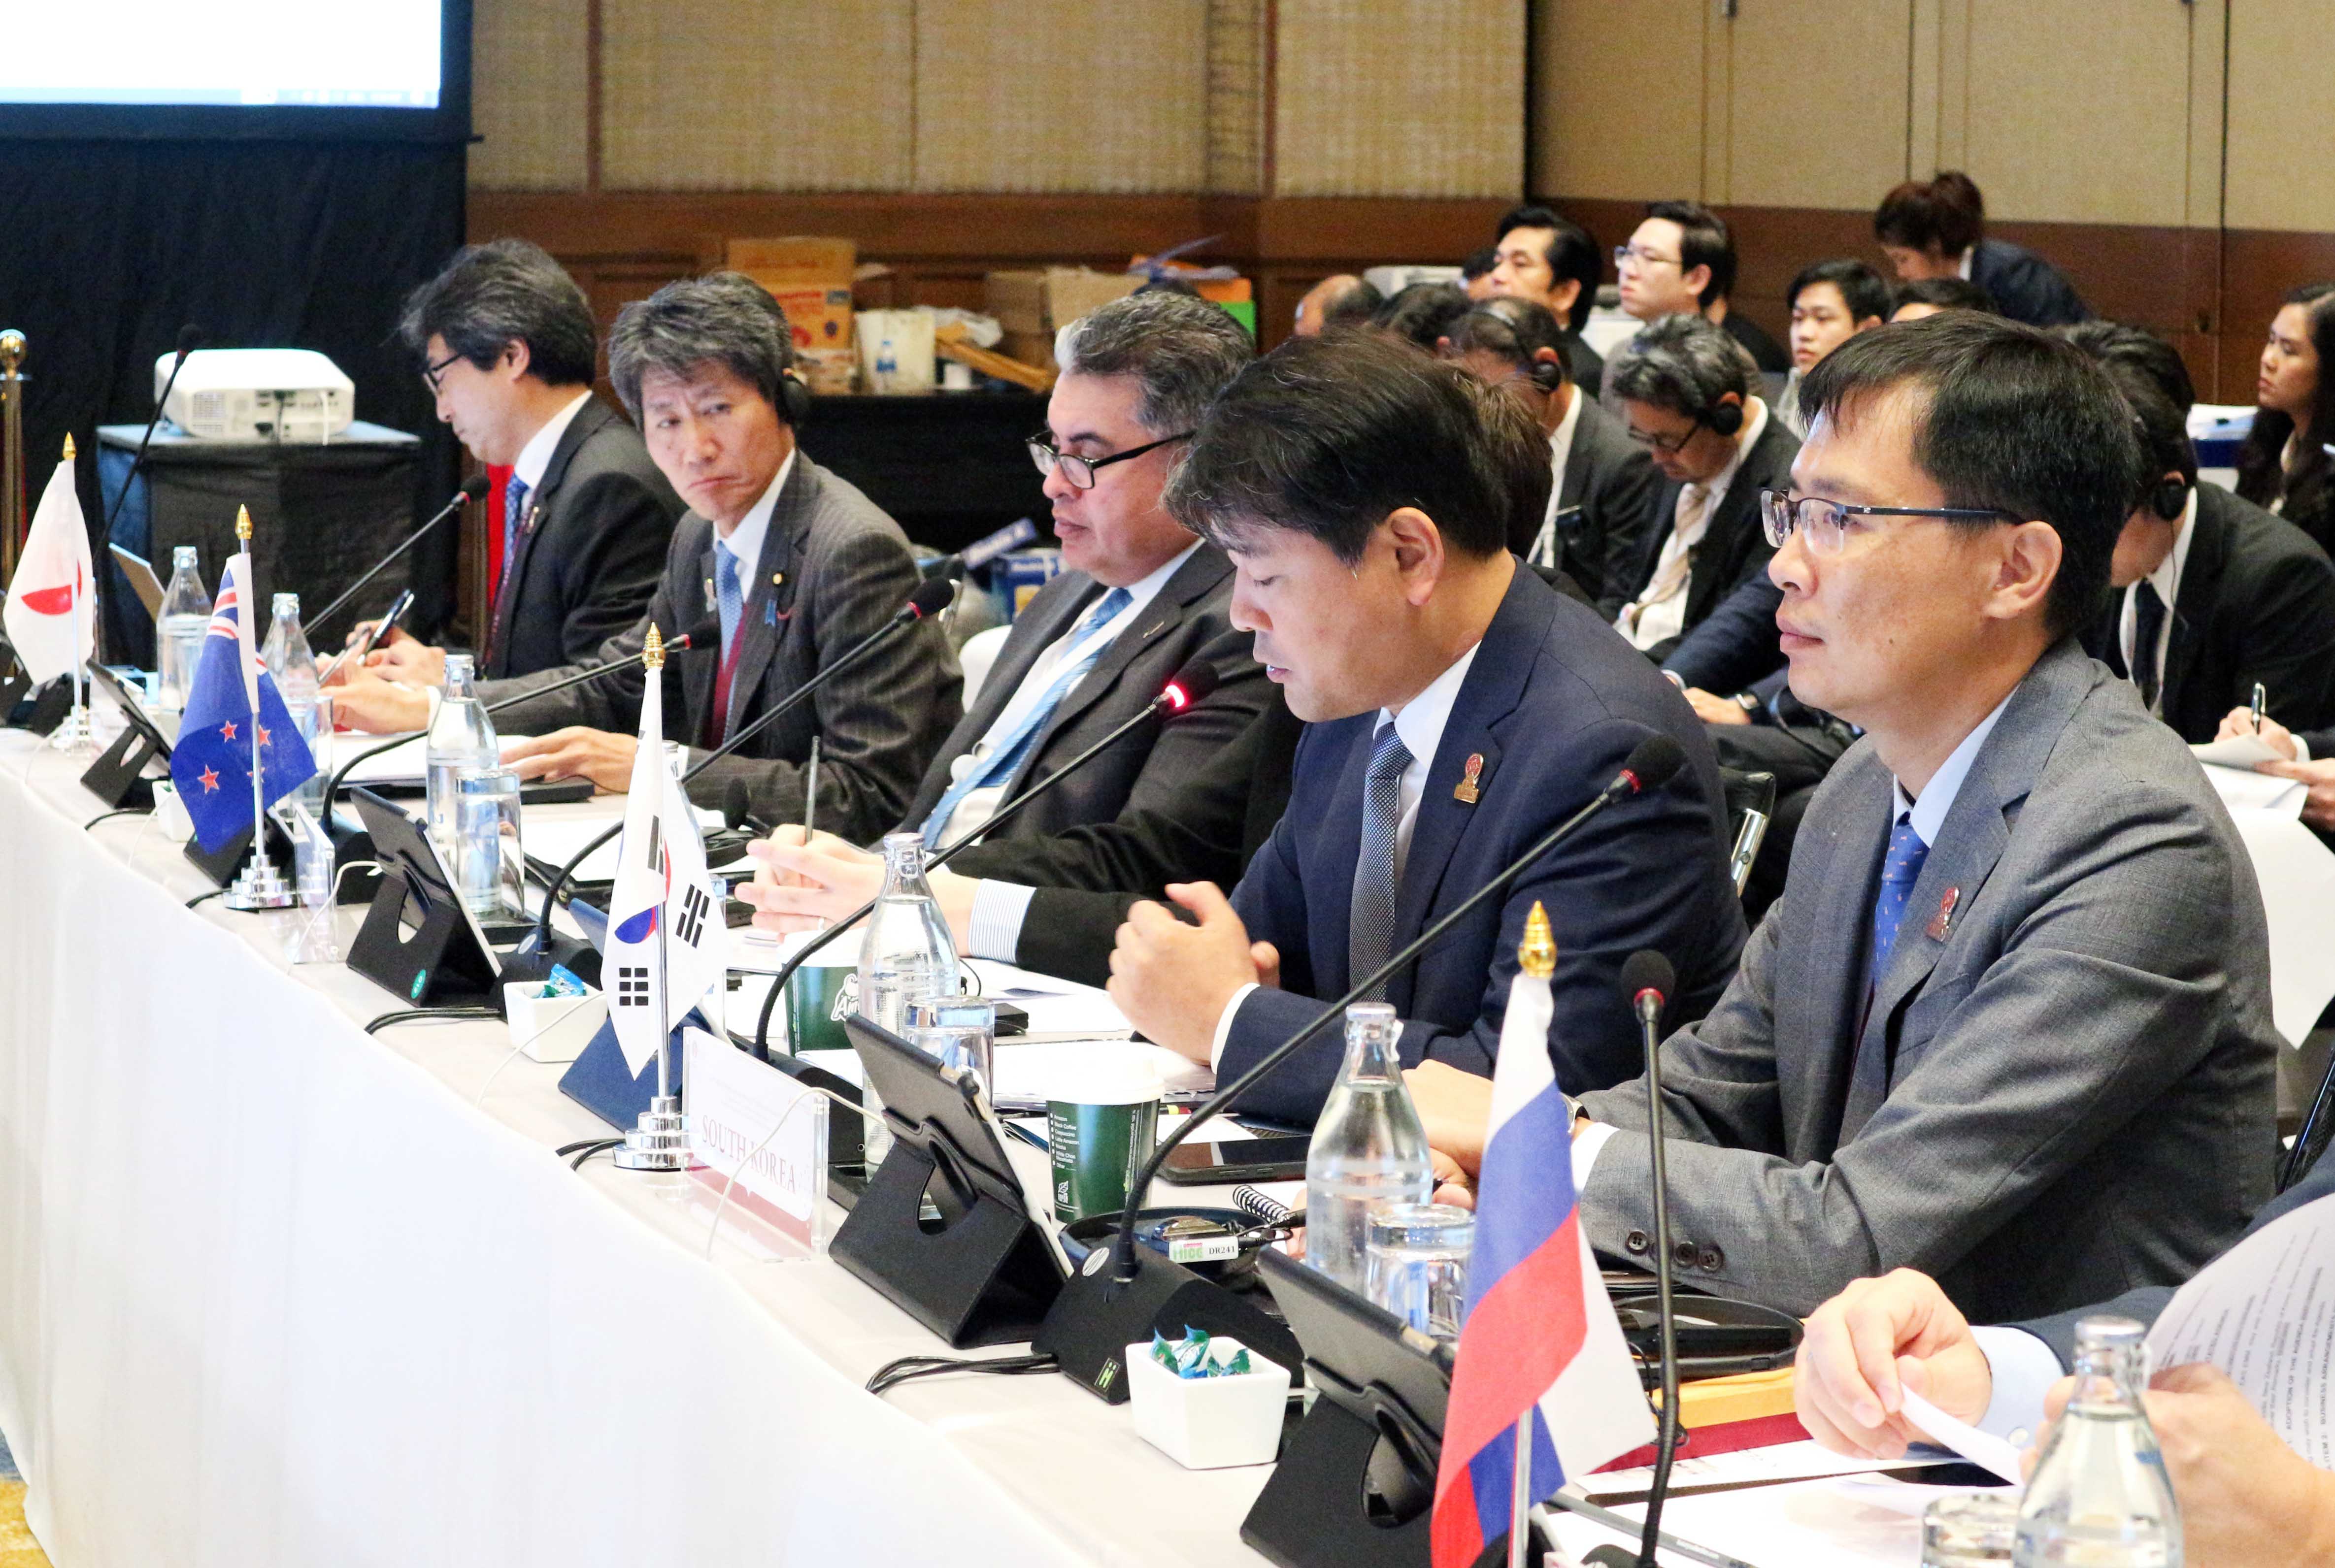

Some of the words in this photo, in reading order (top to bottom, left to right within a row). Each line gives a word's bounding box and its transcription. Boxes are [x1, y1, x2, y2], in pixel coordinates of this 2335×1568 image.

[702, 1115, 746, 1163] SOUTH
[750, 1140, 797, 1194] KOREA
[1209, 1246, 1235, 1255] DR241
